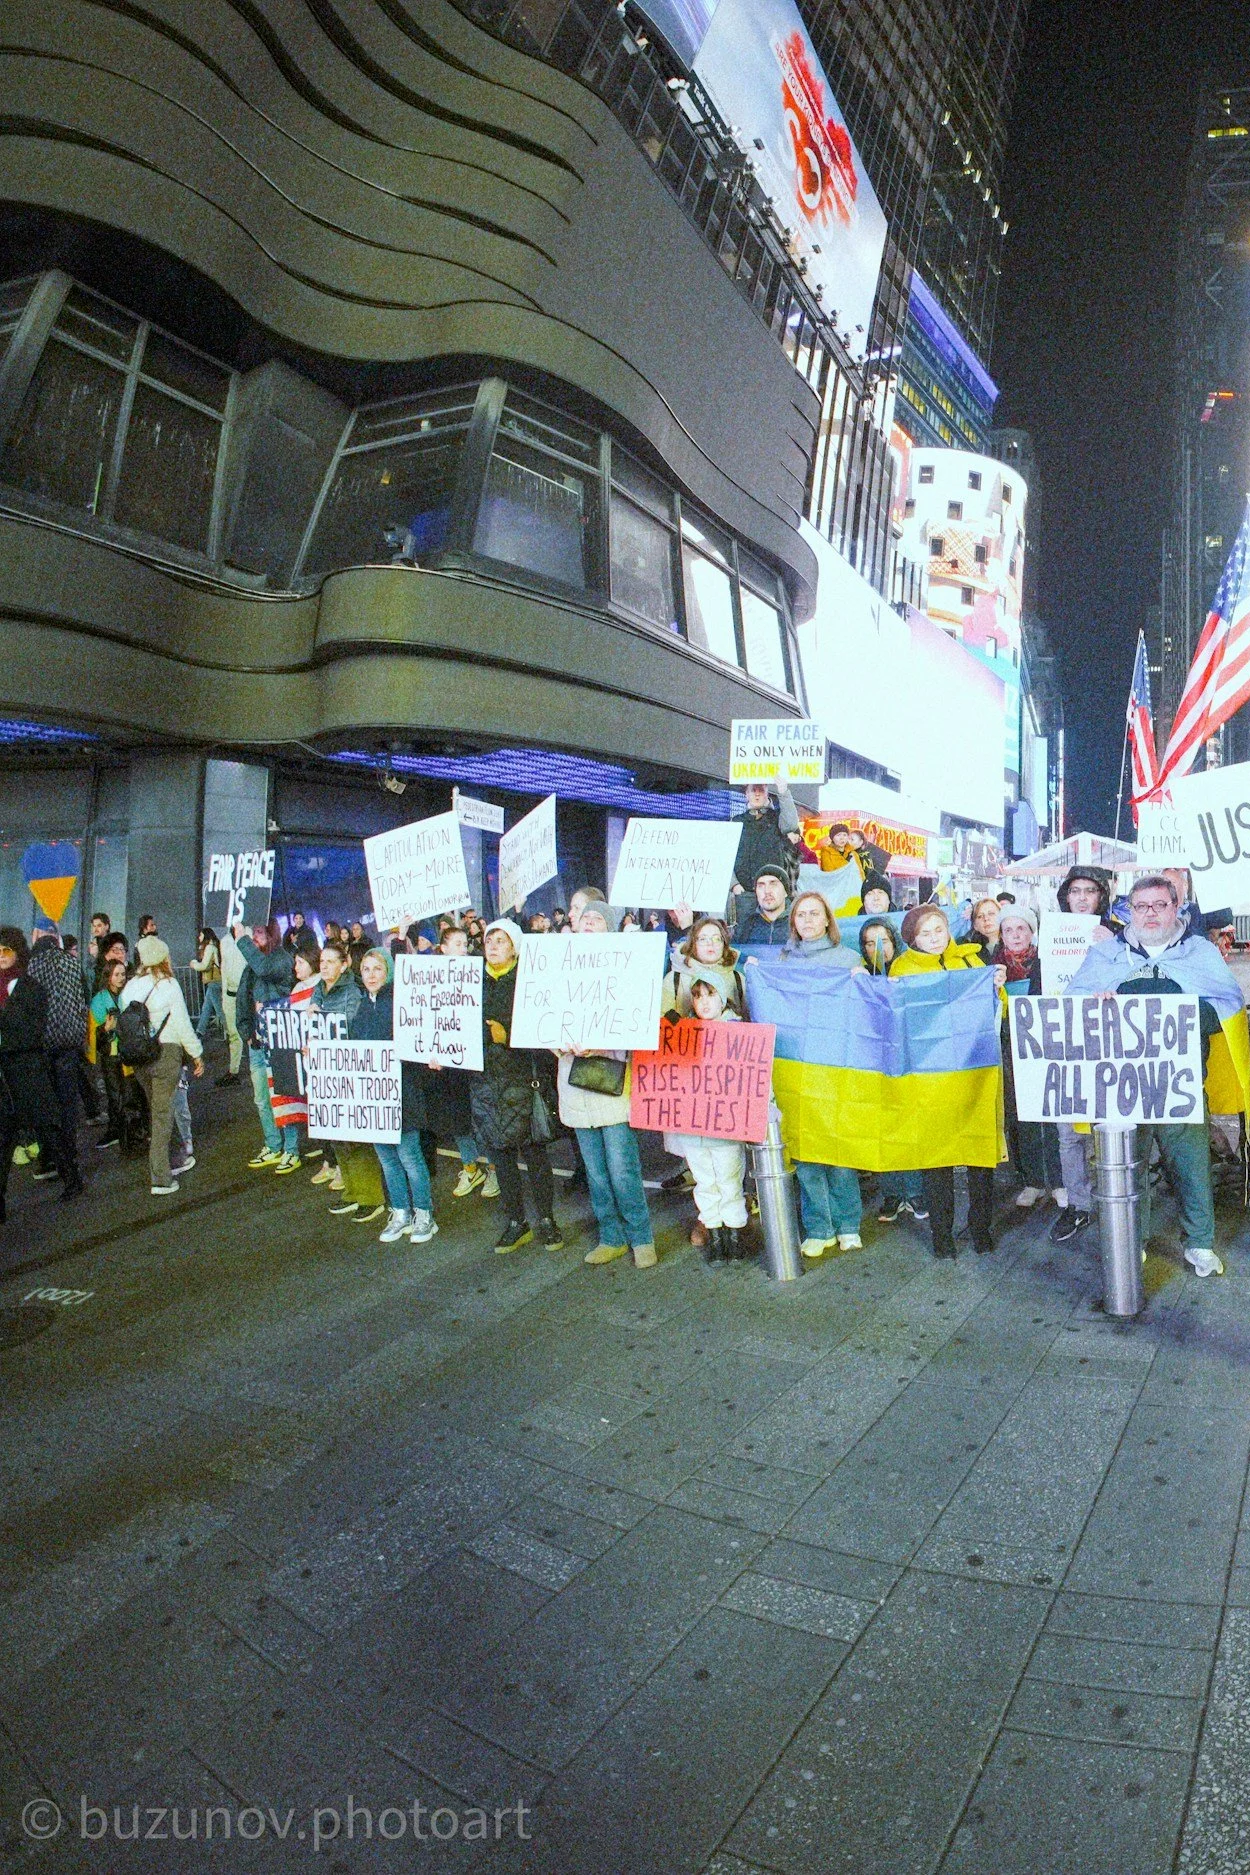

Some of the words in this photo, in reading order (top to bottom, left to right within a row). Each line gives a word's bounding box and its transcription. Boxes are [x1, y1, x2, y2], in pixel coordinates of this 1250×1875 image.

[737, 724, 768, 741] FAIR
[736, 745, 747, 758] IS
[753, 745, 785, 758] ONLY
[789, 744, 823, 757] WHEN
[787, 762, 820, 778] WINS
[373, 827, 451, 871] CAPITULATION
[631, 822, 680, 846] DEFEND
[208, 853, 235, 892] FAIR
[235, 849, 276, 889] PEACE
[640, 872, 704, 904] LAW
[226, 887, 247, 928] IS
[561, 939, 633, 972] AMNESTY
[1053, 936, 1086, 945] KILLING
[523, 981, 552, 1009] FOR
[566, 975, 618, 1007] WAR
[266, 1009, 301, 1050] FAIR
[300, 1010, 348, 1050] PEACE
[414, 1032, 425, 1053] it
[652, 1026, 717, 1058] RUTH
[726, 1032, 769, 1065] WILL
[1014, 997, 1163, 1062] RELEASE
[1163, 1004, 1197, 1056] OF
[309, 1047, 378, 1073] WITHDRAWAL
[381, 1048, 395, 1073] OF
[311, 1075, 355, 1100] RUSSIAN
[357, 1076, 402, 1106] TROOPS,
[637, 1063, 687, 1095] RISE,
[1042, 1062, 1088, 1117] ALL
[1094, 1060, 1197, 1119] POW'S
[308, 1103, 328, 1128] END
[331, 1104, 345, 1129] OF
[348, 1104, 402, 1131] HOSTILITIES
[642, 1098, 682, 1128] THE
